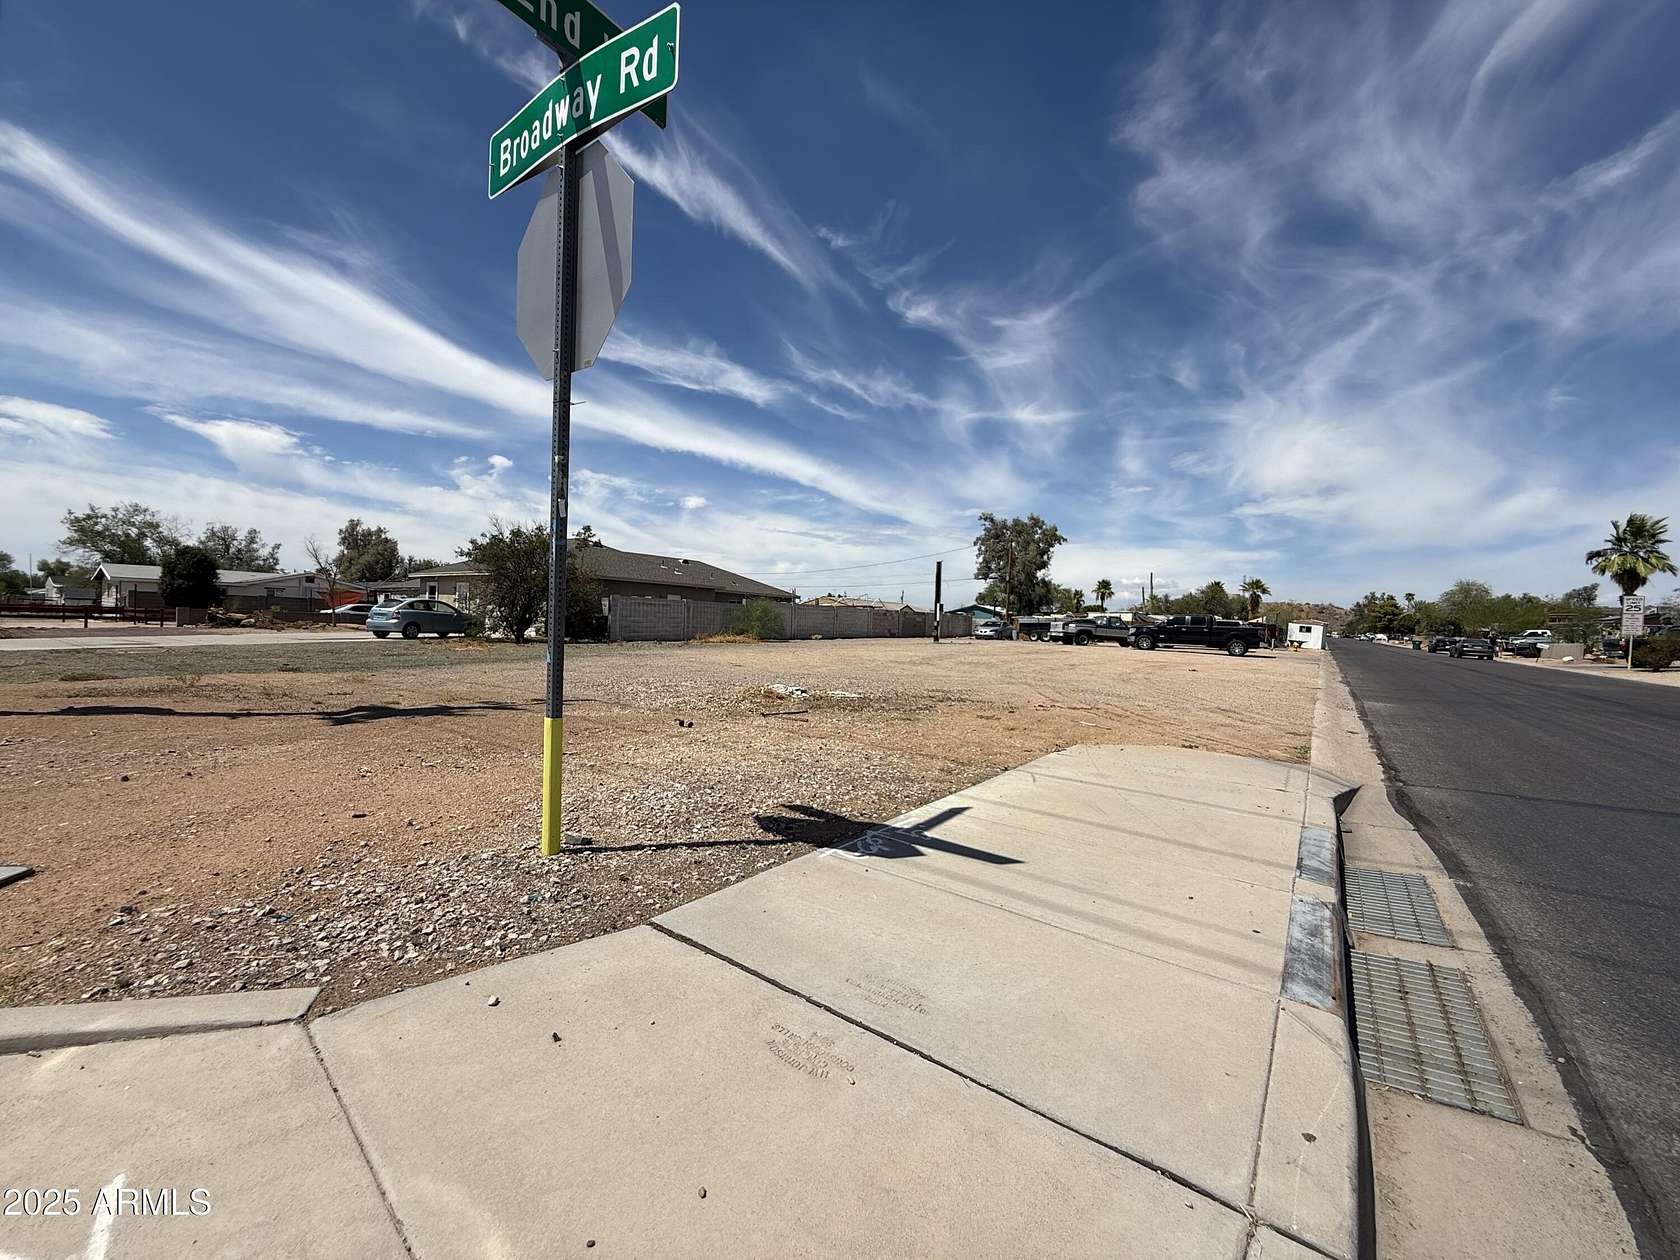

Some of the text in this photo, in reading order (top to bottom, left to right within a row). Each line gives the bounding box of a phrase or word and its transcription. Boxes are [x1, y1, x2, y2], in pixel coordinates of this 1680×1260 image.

[521, 0, 581, 49] nd
[500, 34, 659, 177] Broadway Rd
